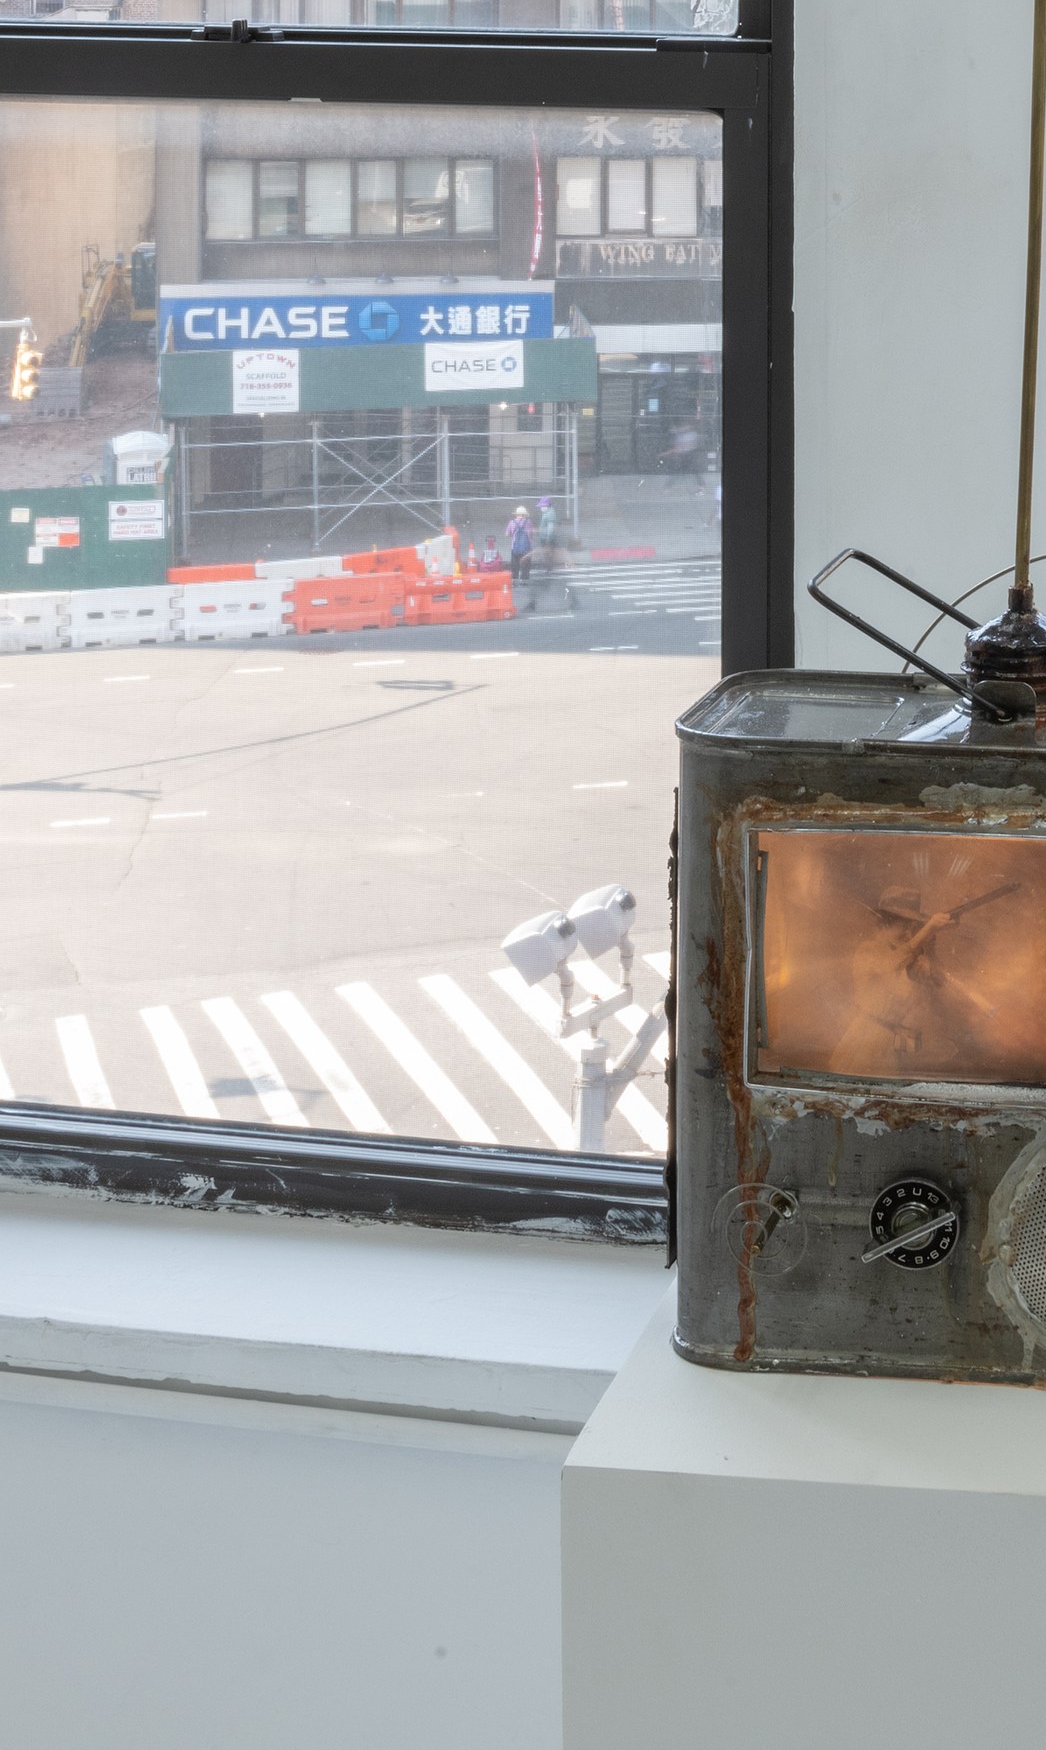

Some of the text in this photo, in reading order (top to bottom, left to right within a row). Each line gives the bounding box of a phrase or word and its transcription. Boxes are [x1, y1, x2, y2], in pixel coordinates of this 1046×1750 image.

[599, 244, 656, 261] WING
[184, 306, 349, 340] CHASE
[420, 305, 531, 336] 大通銀行
[236, 353, 296, 369] UPTOWN
[431, 358, 497, 374] CHASE
[246, 372, 287, 380] SCAFFOLD
[896, 1188, 906, 1198] 2
[927, 1192, 940, 1204] 13
[882, 1196, 893, 1207] 3
[876, 1211, 885, 1221] 4
[876, 1225, 884, 1234] 5
[939, 1236, 950, 1250] 10
[898, 1254, 907, 1263] 7
[915, 1256, 924, 1264] 8
